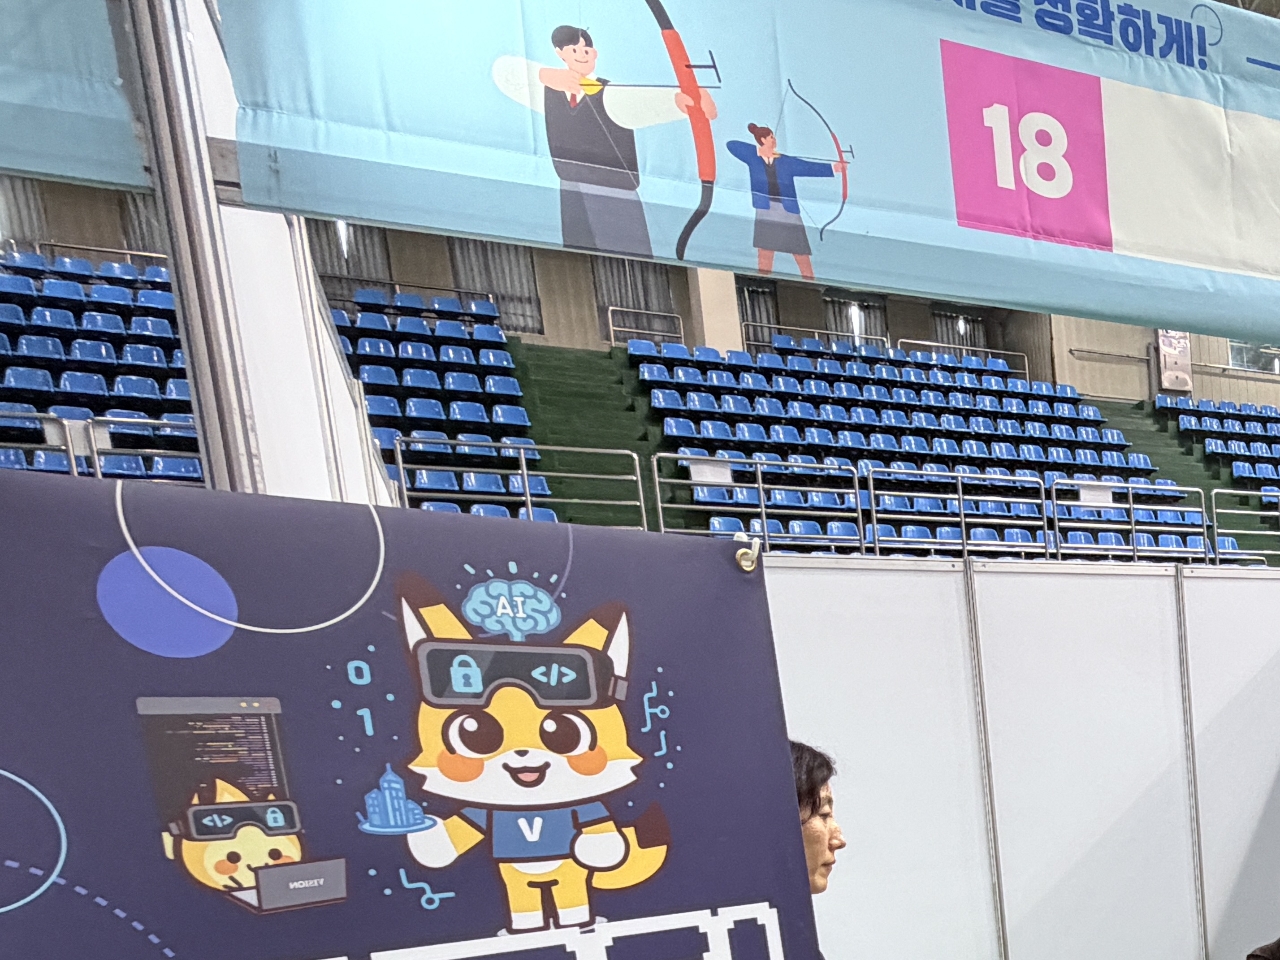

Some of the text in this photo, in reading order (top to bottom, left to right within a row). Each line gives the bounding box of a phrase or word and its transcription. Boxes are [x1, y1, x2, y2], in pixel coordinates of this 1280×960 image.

[982, 102, 1074, 199] 18
[496, 595, 527, 618] AI
[347, 660, 371, 685] 0
[356, 707, 374, 736] 1
[517, 816, 543, 842] V
